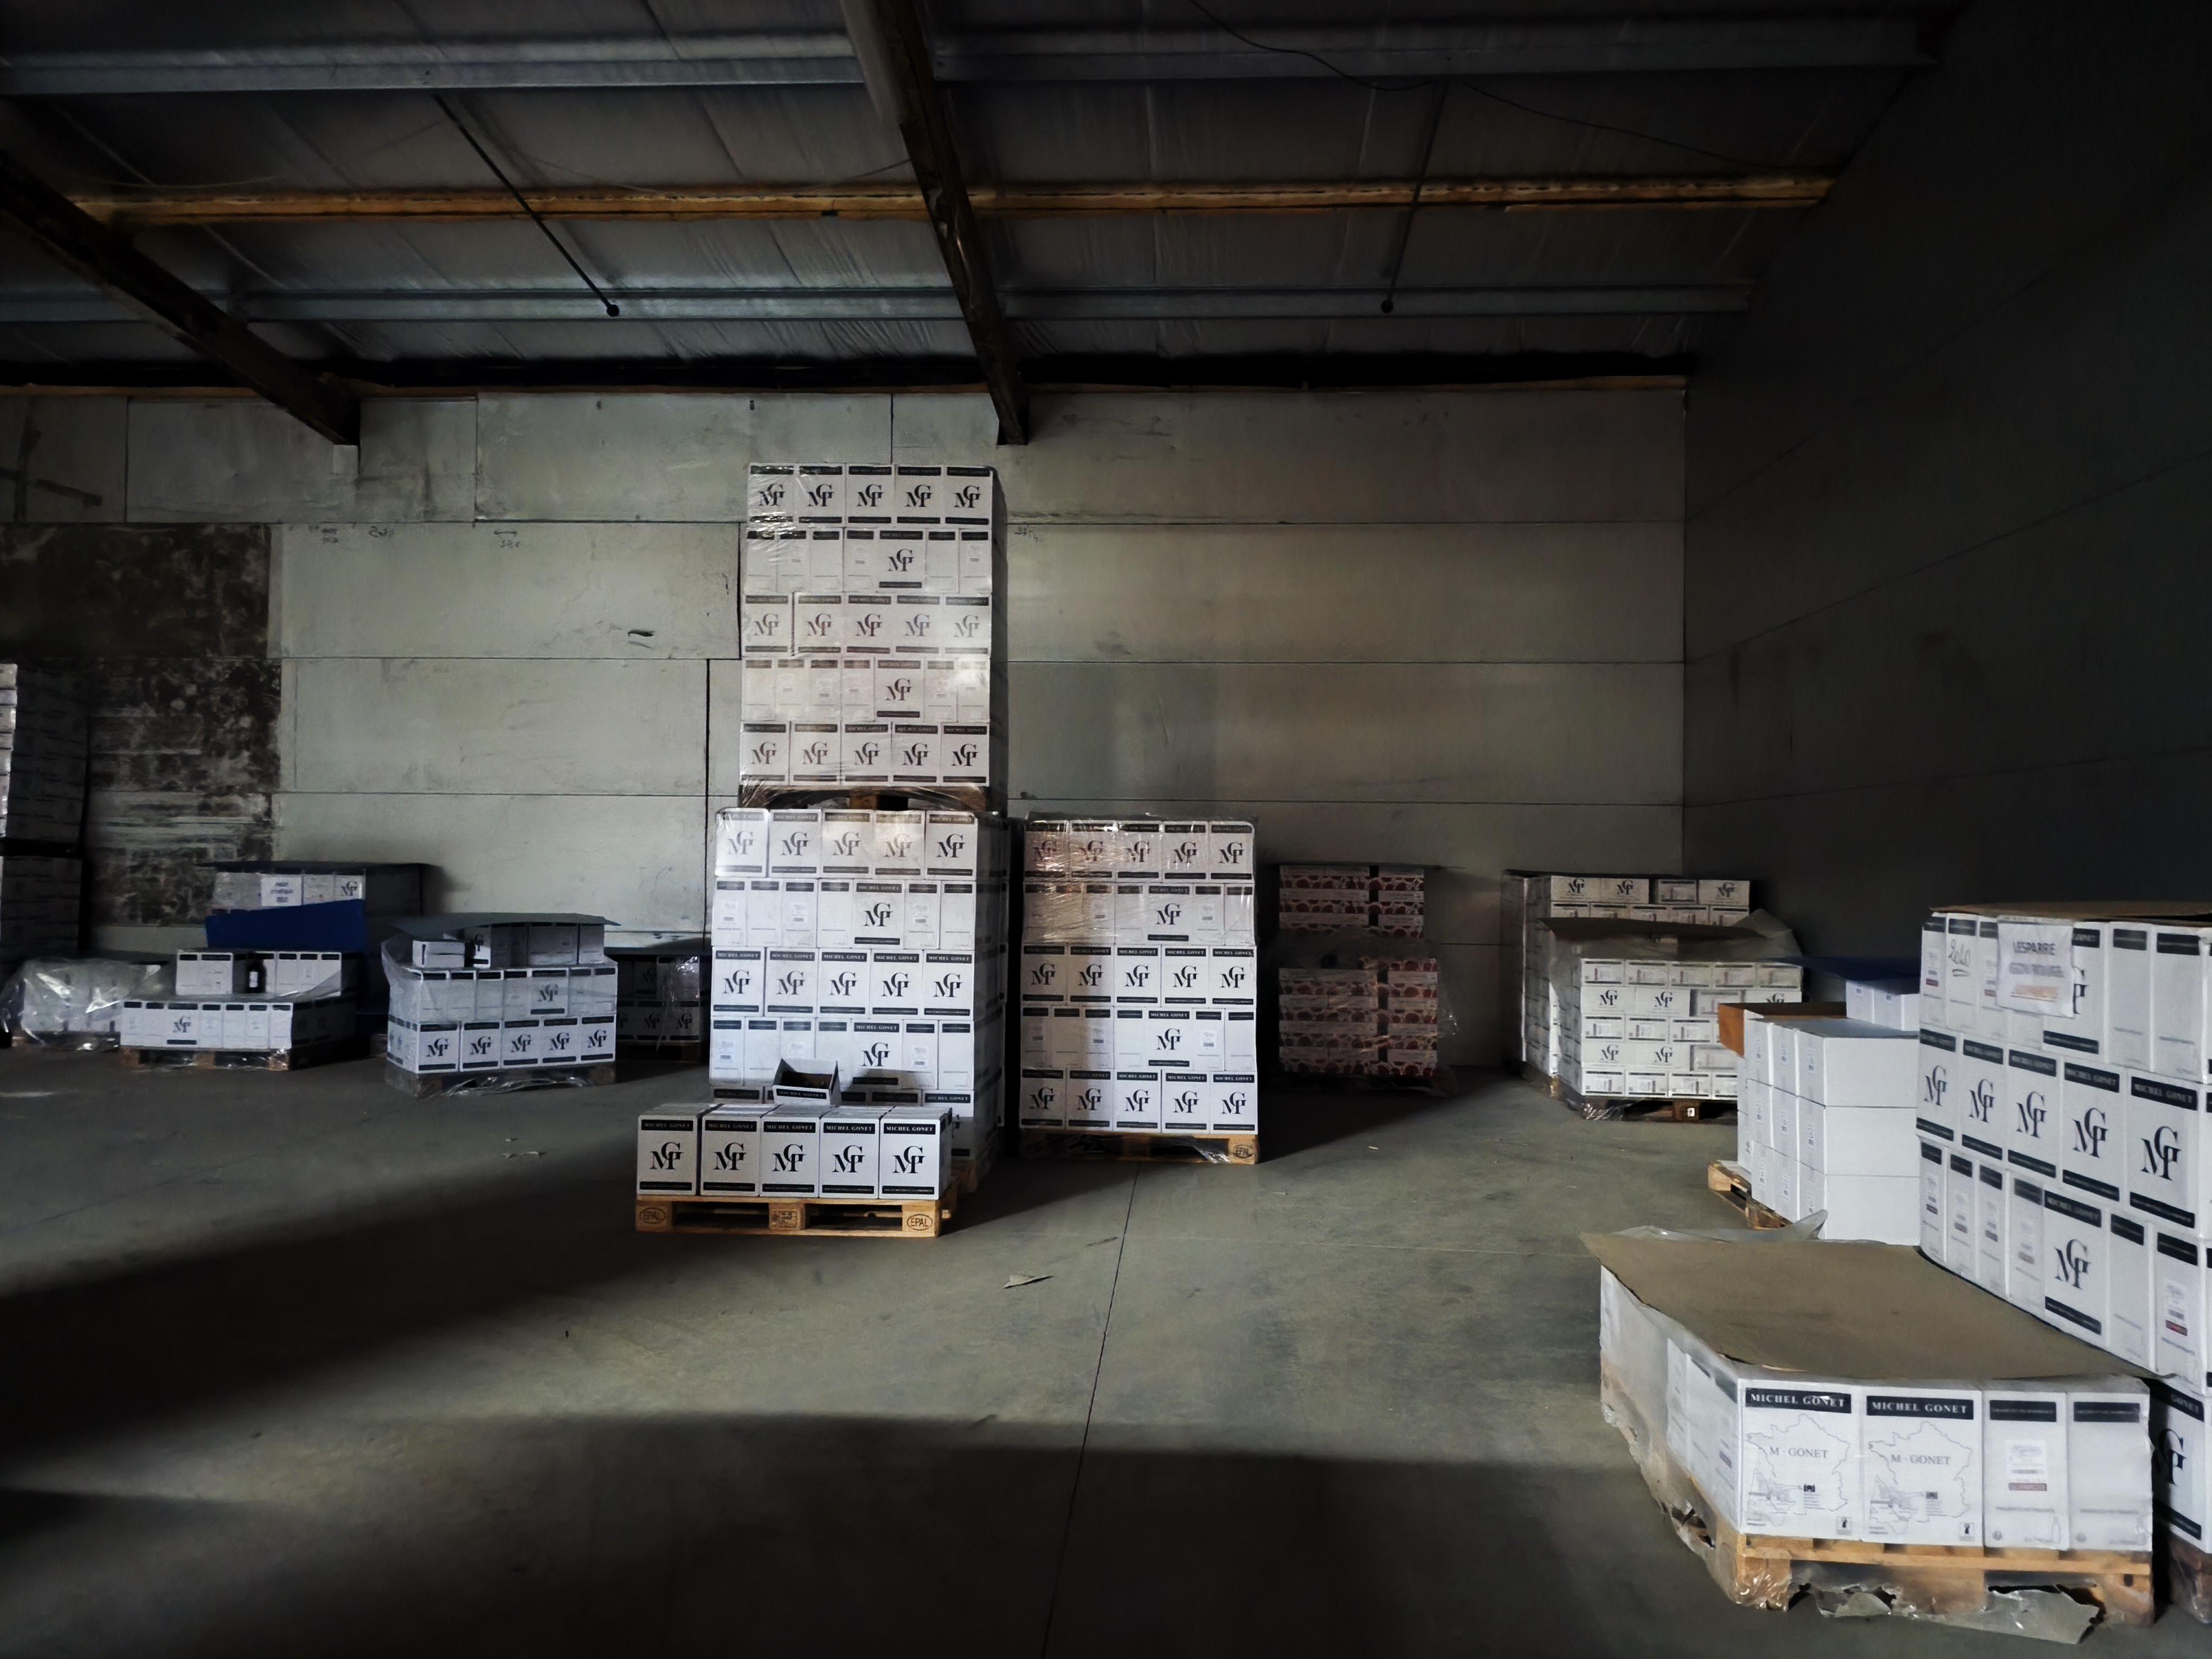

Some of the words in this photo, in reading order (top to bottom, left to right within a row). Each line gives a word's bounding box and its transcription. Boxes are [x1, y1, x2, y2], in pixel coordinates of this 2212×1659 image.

[2134, 1084, 2163, 1097] MICHEL
[2166, 1090, 2194, 1104] GONET
[643, 1210, 663, 1220] EPAL
[910, 1218, 929, 1227] EPAL
[1750, 1393, 1798, 1404] MICHEL
[1803, 1396, 1846, 1407] GONET
[2171, 1394, 2200, 1414] GONET
[1872, 1401, 1920, 1412] MICHEL
[1925, 1404, 1967, 1414] GONET
[1769, 1446, 1779, 1456] M
[1788, 1447, 1829, 1458] GONET
[1909, 1454, 1951, 1465] GONET
